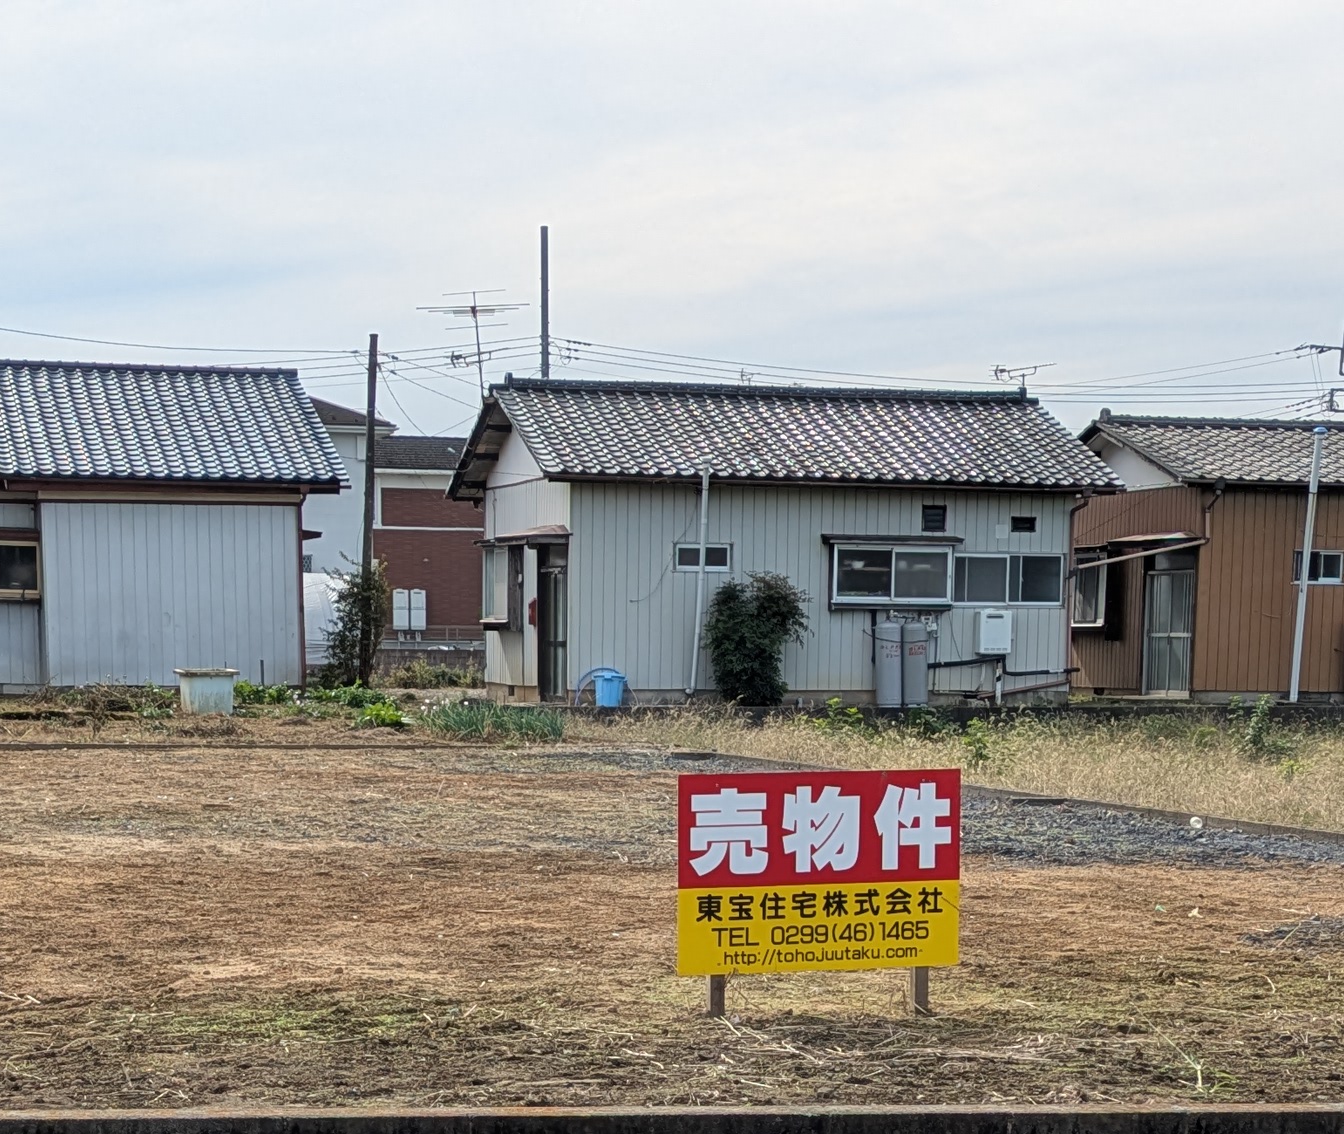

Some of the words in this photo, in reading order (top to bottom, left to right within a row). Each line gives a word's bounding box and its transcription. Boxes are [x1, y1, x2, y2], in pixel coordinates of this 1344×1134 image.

[689, 782, 952, 876] 売物件
[696, 887, 943, 922] 東宝住宅株式会社
[711, 927, 760, 947] TEL
[771, 920, 929, 946] 0299(46)1465
[723, 946, 918, 966] http://tohojuutaku.com
